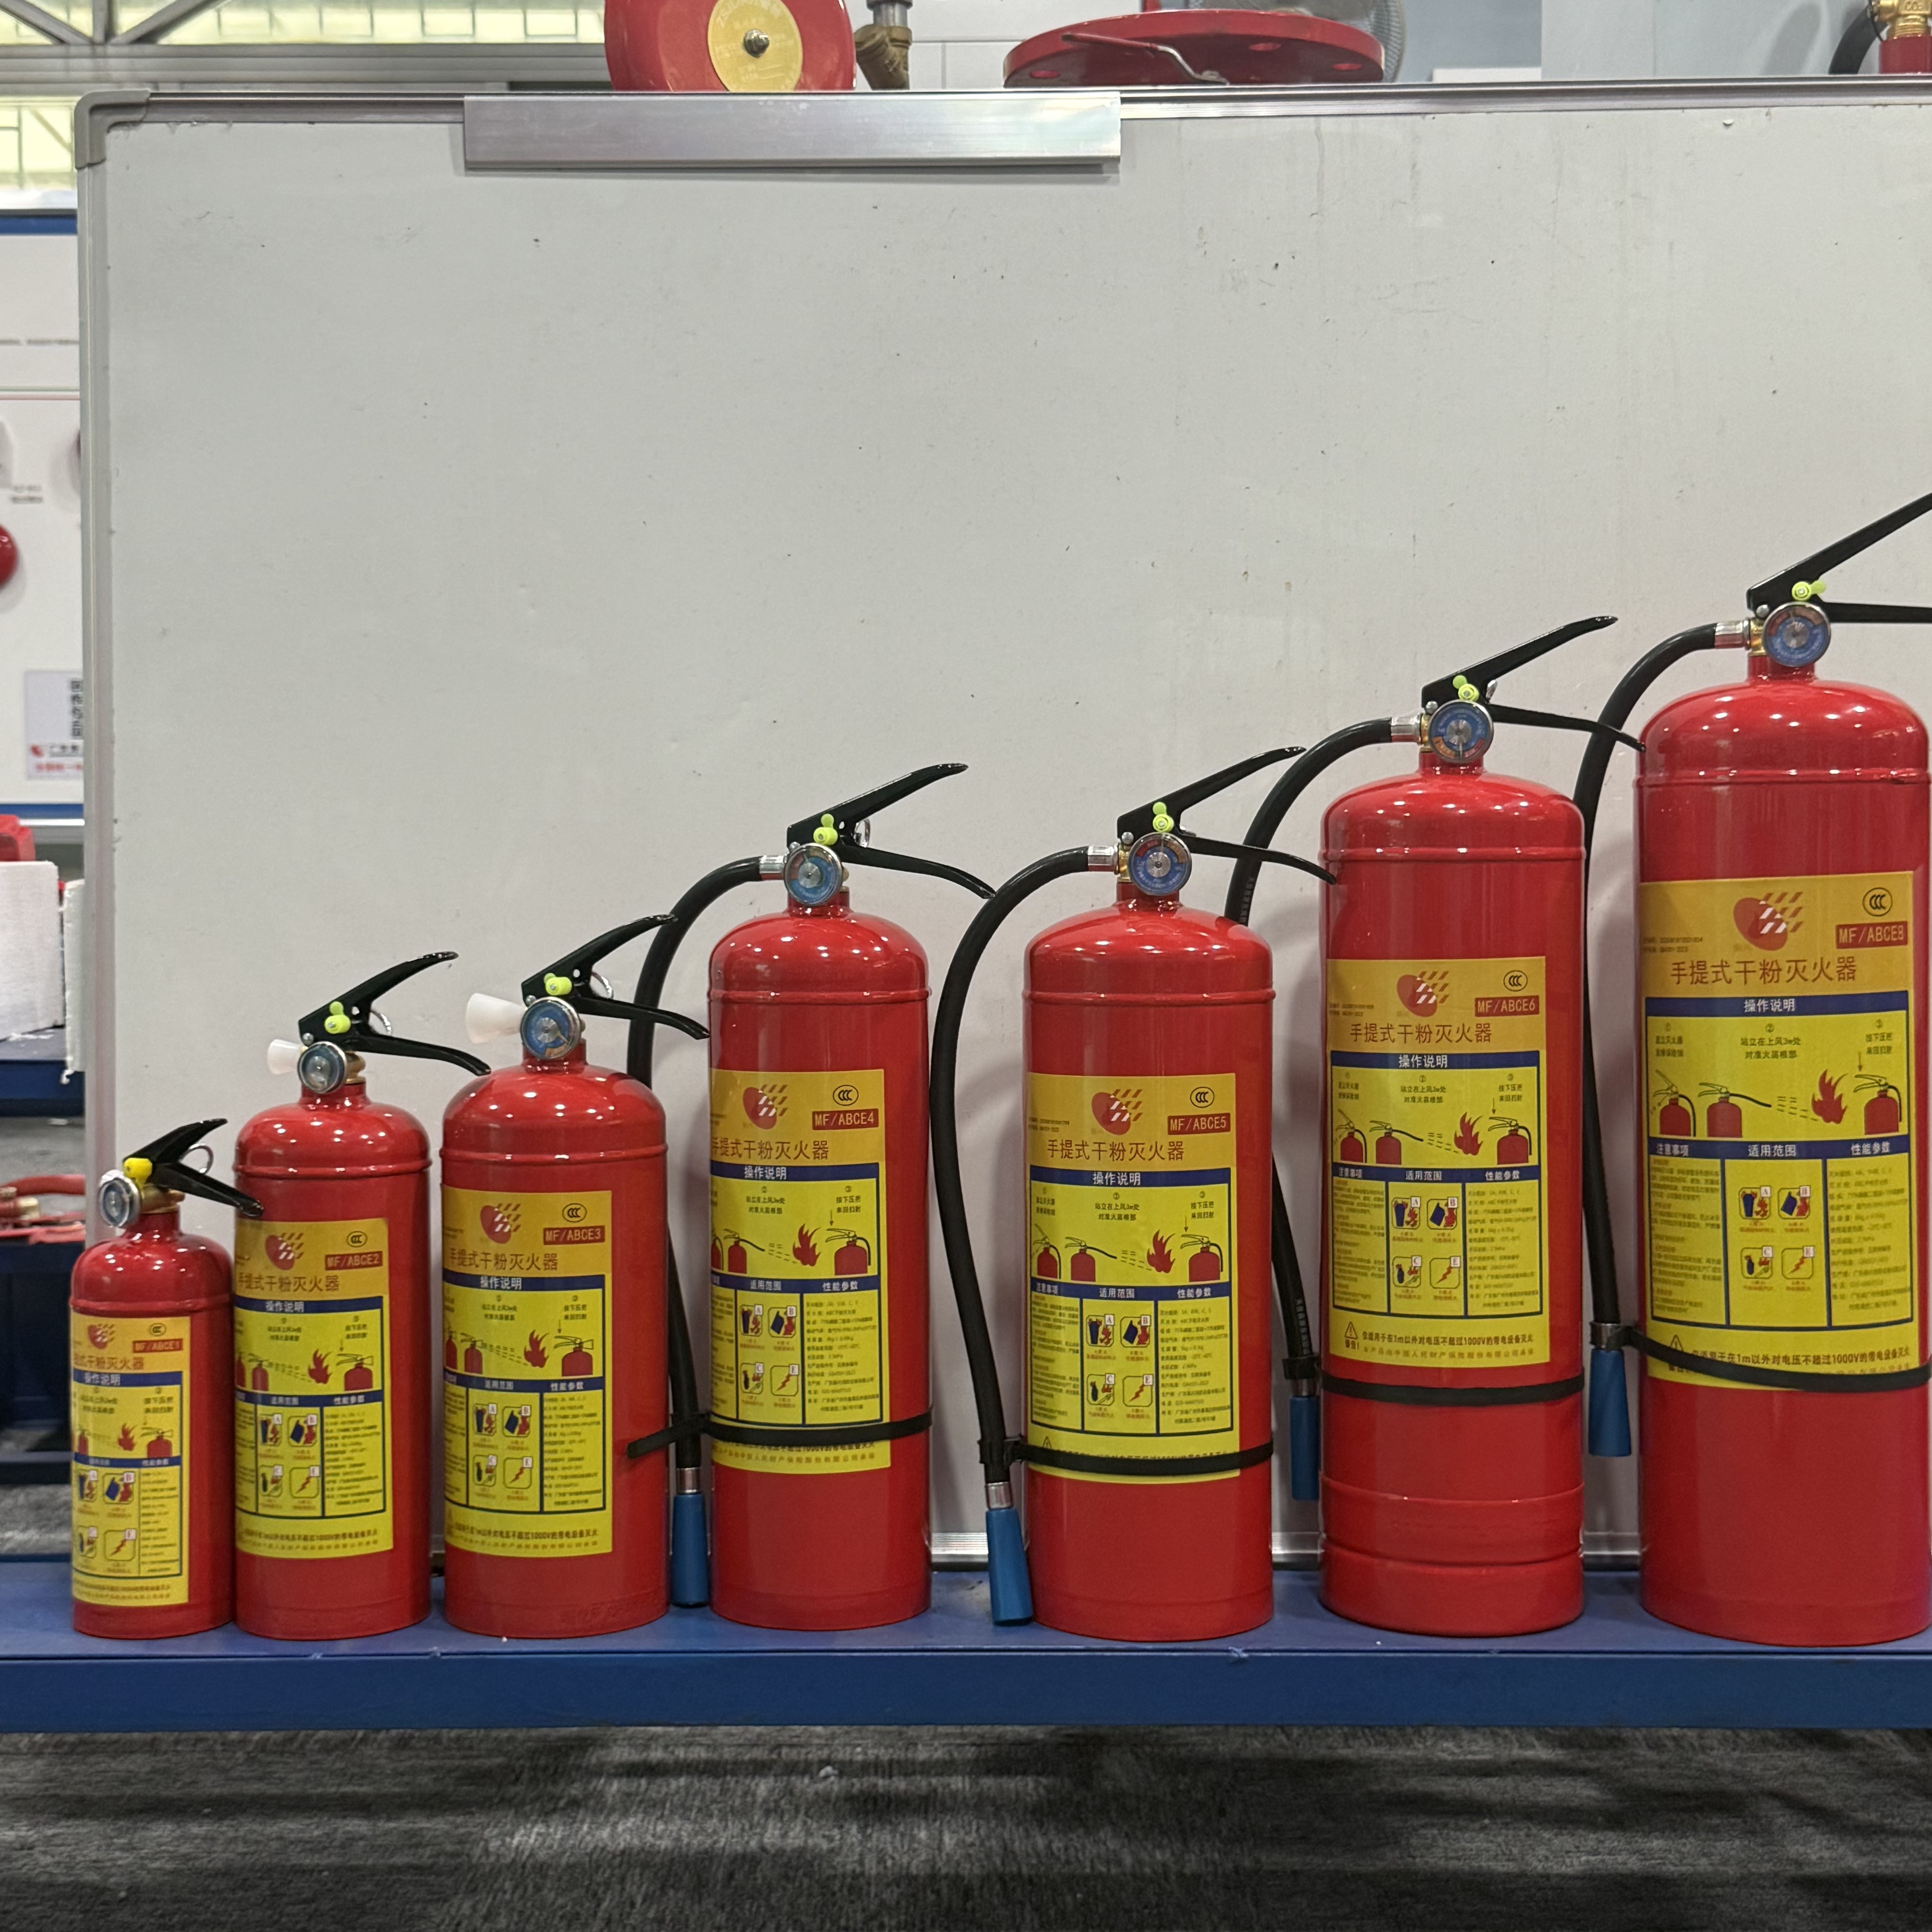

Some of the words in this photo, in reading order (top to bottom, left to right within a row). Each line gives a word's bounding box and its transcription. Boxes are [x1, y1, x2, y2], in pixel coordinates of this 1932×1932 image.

[1839, 925, 1904, 944] MF/ABCE8
[1670, 957, 1857, 985] 手提式干粉灭火器
[1477, 998, 1536, 1012] MF/ABCE6
[1744, 998, 1795, 1012] 操作说明
[1350, 1023, 1492, 1044] 手提式干粉灭火器
[1398, 1054, 1448, 1068] 操作说明
[814, 1111, 874, 1127] MF/ABCE4
[1170, 1116, 1227, 1131] MF/ABCE5
[1047, 1139, 1184, 1161] 手提式干粉灭火器
[1656, 1142, 1689, 1156] 注意事项
[1748, 1144, 1797, 1157] 适用范围
[1851, 1141, 1891, 1155] 性能参数
[744, 1166, 787, 1180] 操作说明
[1093, 1172, 1141, 1186] 操作说明
[1405, 1171, 1442, 1181] 适用范围
[1485, 1169, 1520, 1181] 性能参数
[545, 1228, 601, 1242] MF/ABCE3
[327, 1253, 380, 1267] MF/ABCE2
[450, 1248, 558, 1271] 手提式干粉灭火器
[480, 1276, 522, 1290] 操作说明
[750, 1281, 782, 1291] 适用范围
[822, 1281, 858, 1291] 性能参数
[1099, 1288, 1135, 1298] 适用范围
[1178, 1288, 1212, 1298] 性能参数
[551, 1381, 584, 1391] 性能参数
